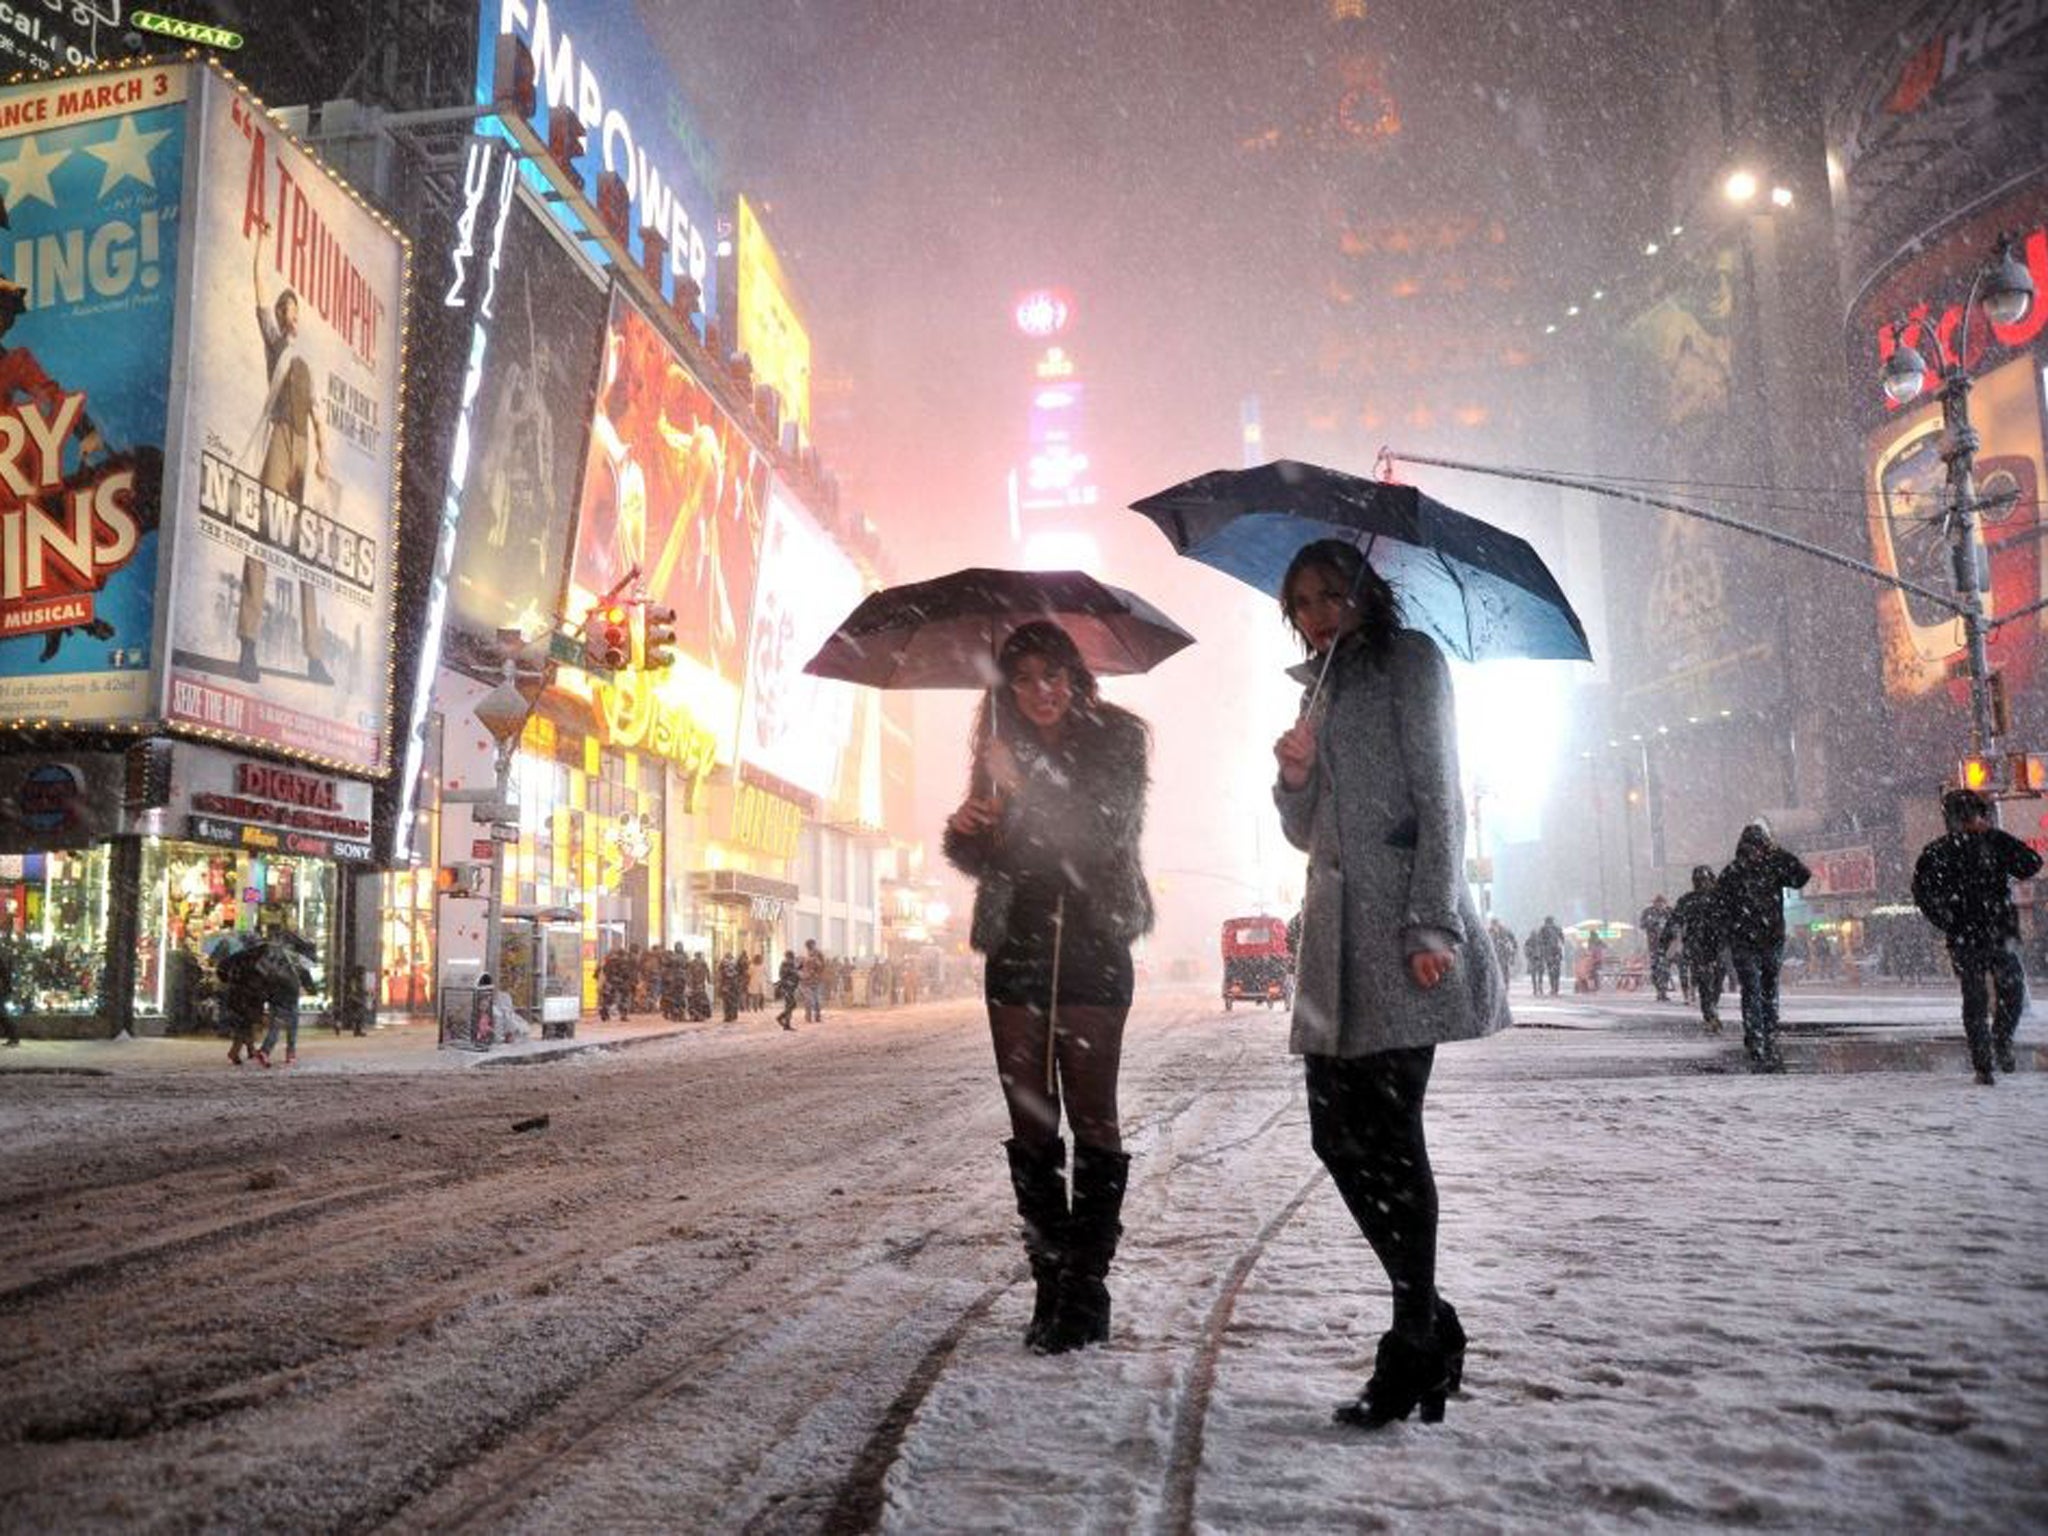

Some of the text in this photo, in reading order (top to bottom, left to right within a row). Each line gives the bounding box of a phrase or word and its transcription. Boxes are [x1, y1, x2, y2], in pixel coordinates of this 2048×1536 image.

[140, 12, 231, 47] LAMAR
[55, 76, 142, 117] MARCH
[153, 72, 169, 96] 3
[200, 456, 375, 587] NEWSIES
[4, 601, 86, 628] MUSICAL
[334, 841, 372, 861] SONY
